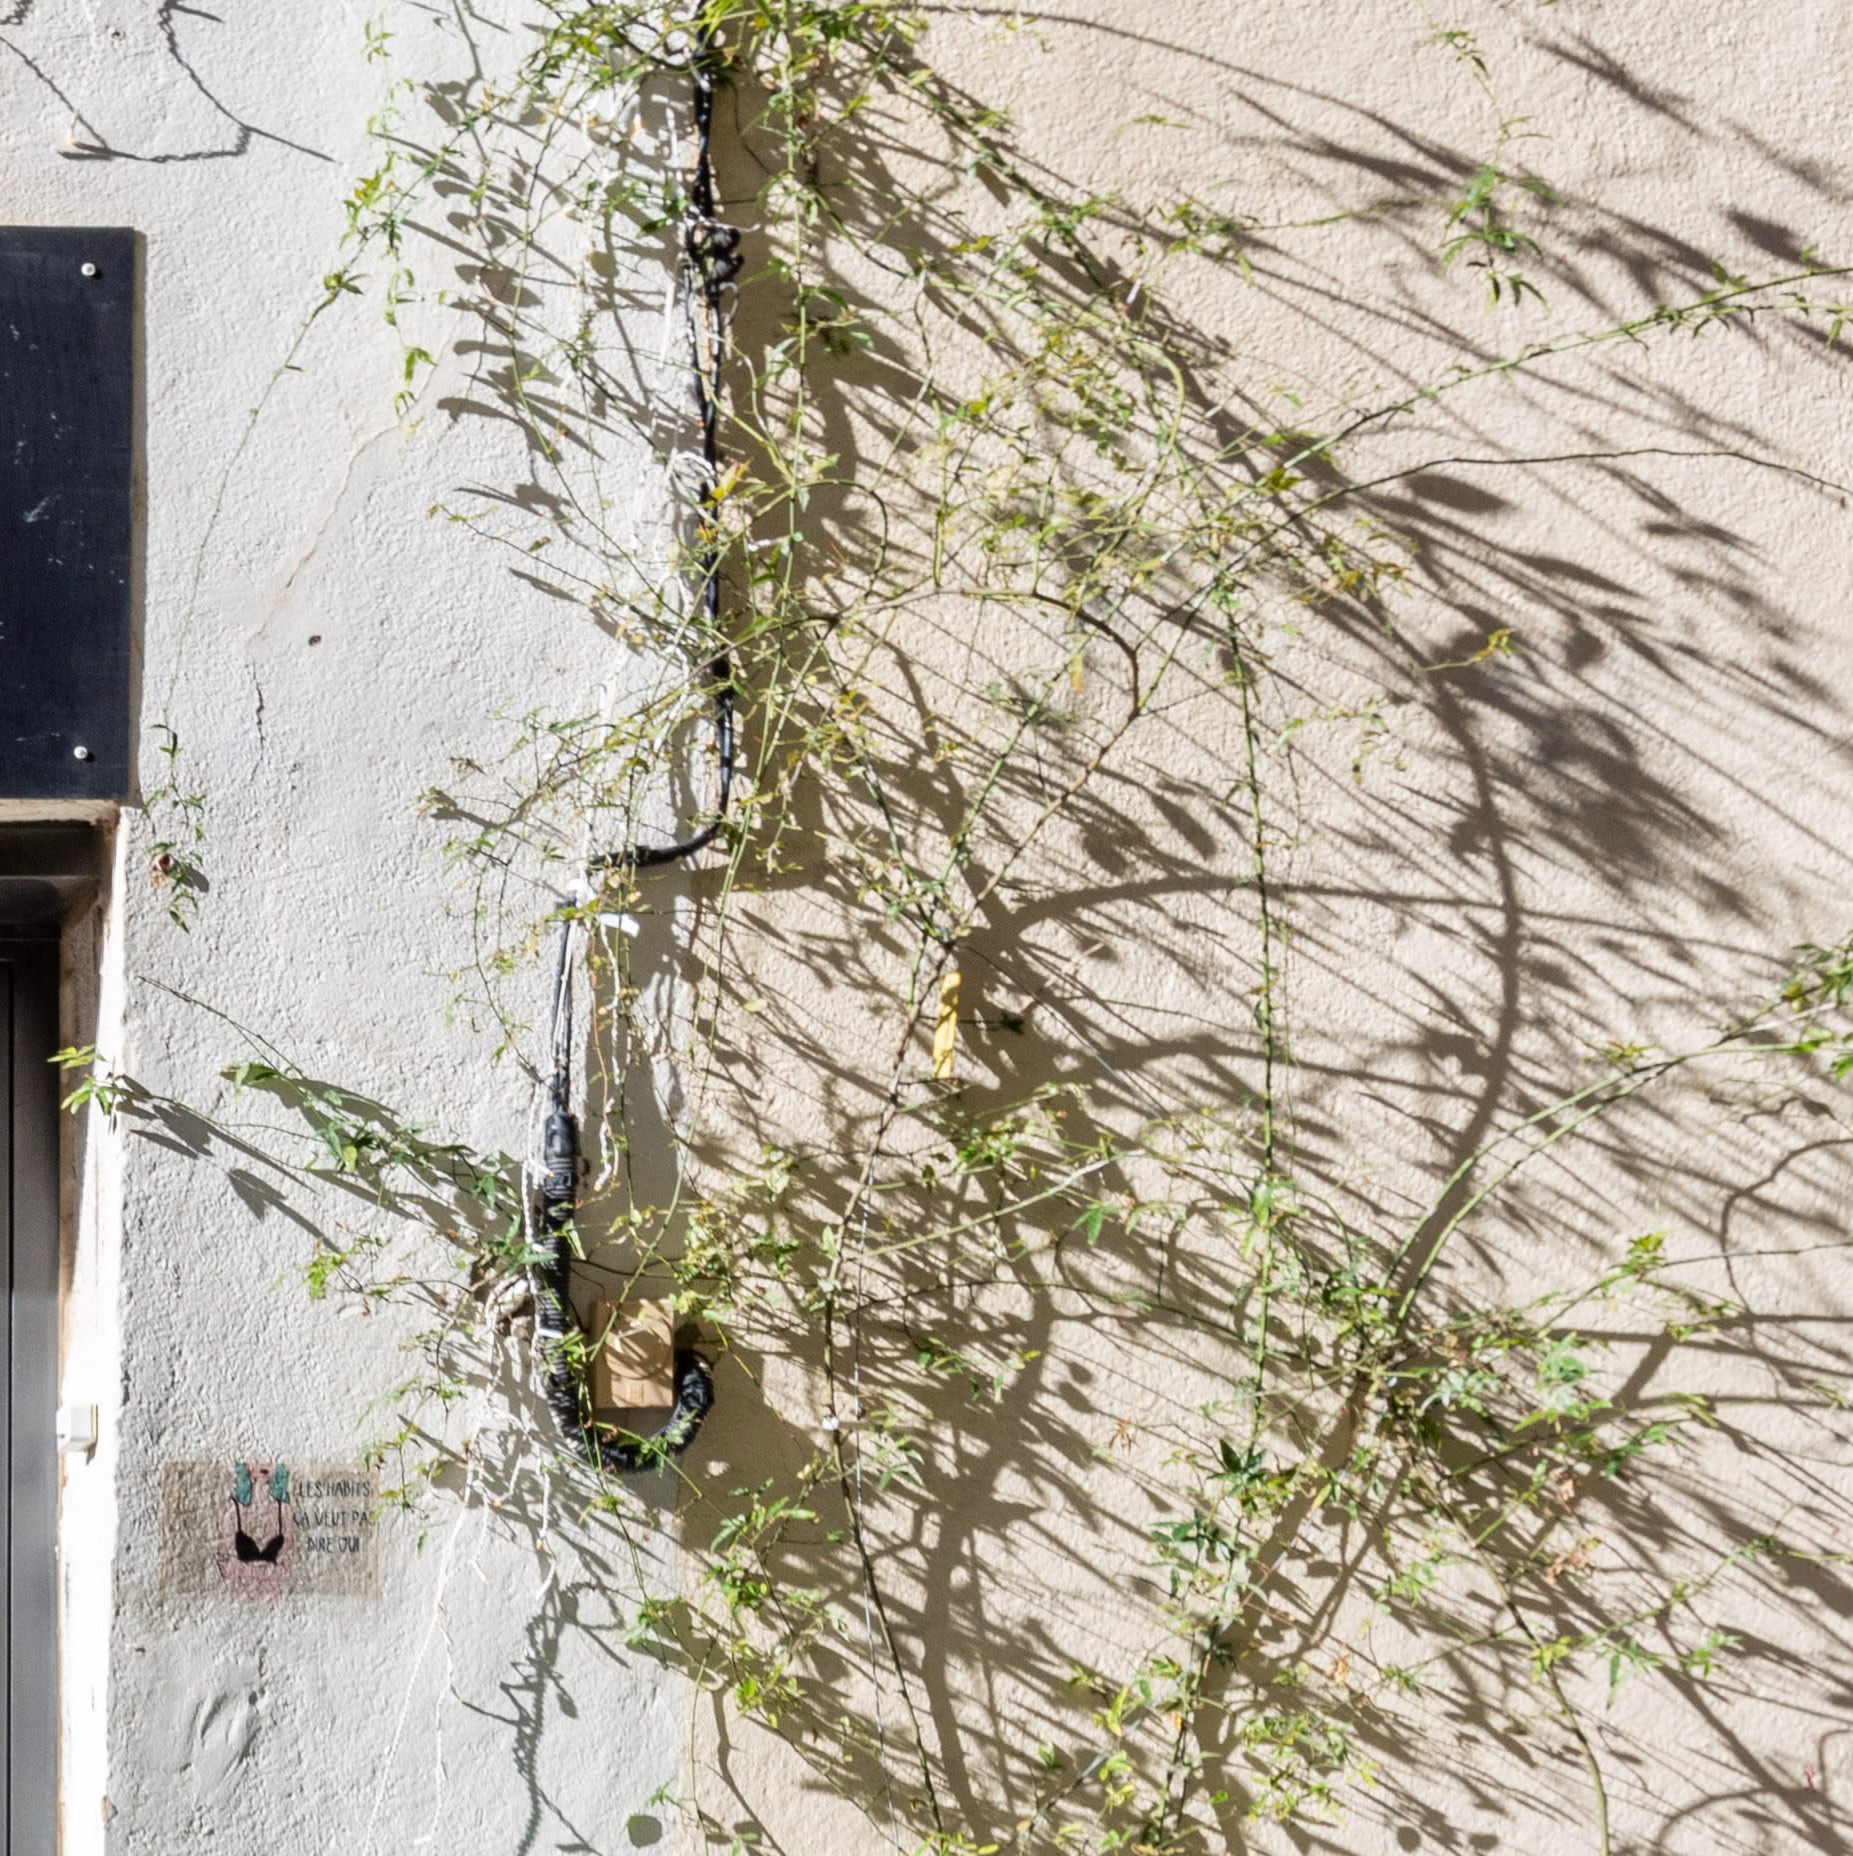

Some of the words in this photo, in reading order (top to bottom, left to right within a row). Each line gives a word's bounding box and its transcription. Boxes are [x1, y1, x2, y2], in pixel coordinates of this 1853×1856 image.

[298, 1481, 323, 1499] LES
[326, 1480, 371, 1497] HABITS
[314, 1511, 348, 1527] VEUT
[306, 1536, 333, 1554] DIRE
[337, 1536, 361, 1553] OUI
